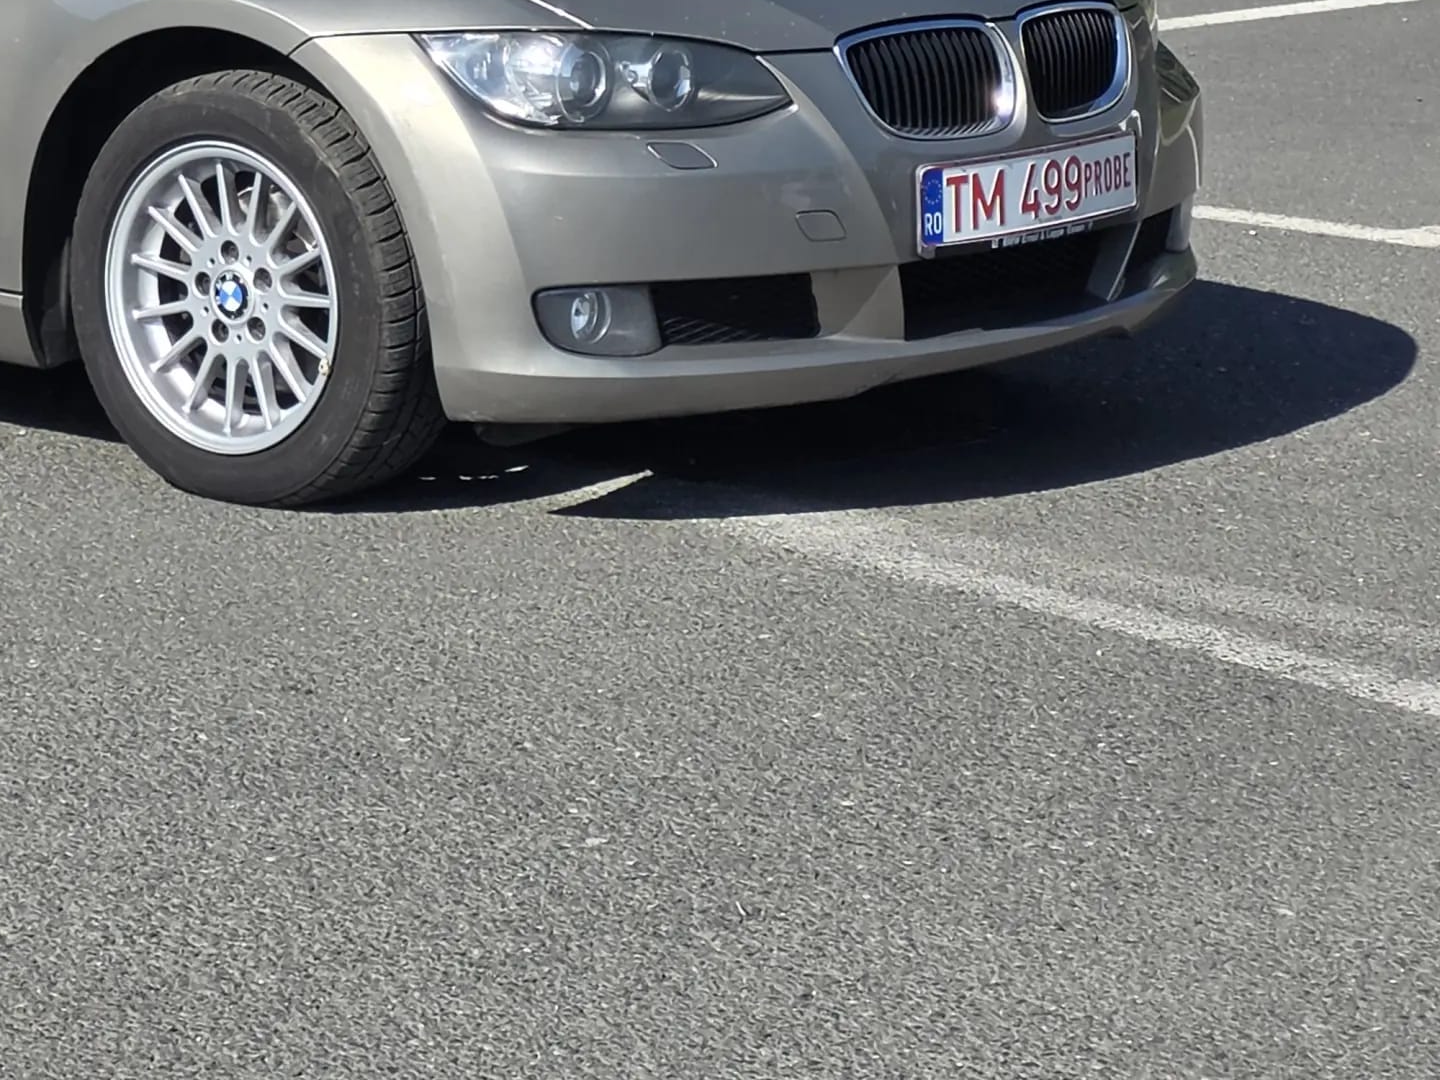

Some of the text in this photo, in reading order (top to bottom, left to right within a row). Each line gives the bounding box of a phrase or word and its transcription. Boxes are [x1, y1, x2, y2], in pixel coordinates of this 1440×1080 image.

[946, 168, 1006, 235] TM
[1019, 155, 1082, 220] 499
[1083, 152, 1132, 198] PROBE
[924, 211, 943, 236] RO
